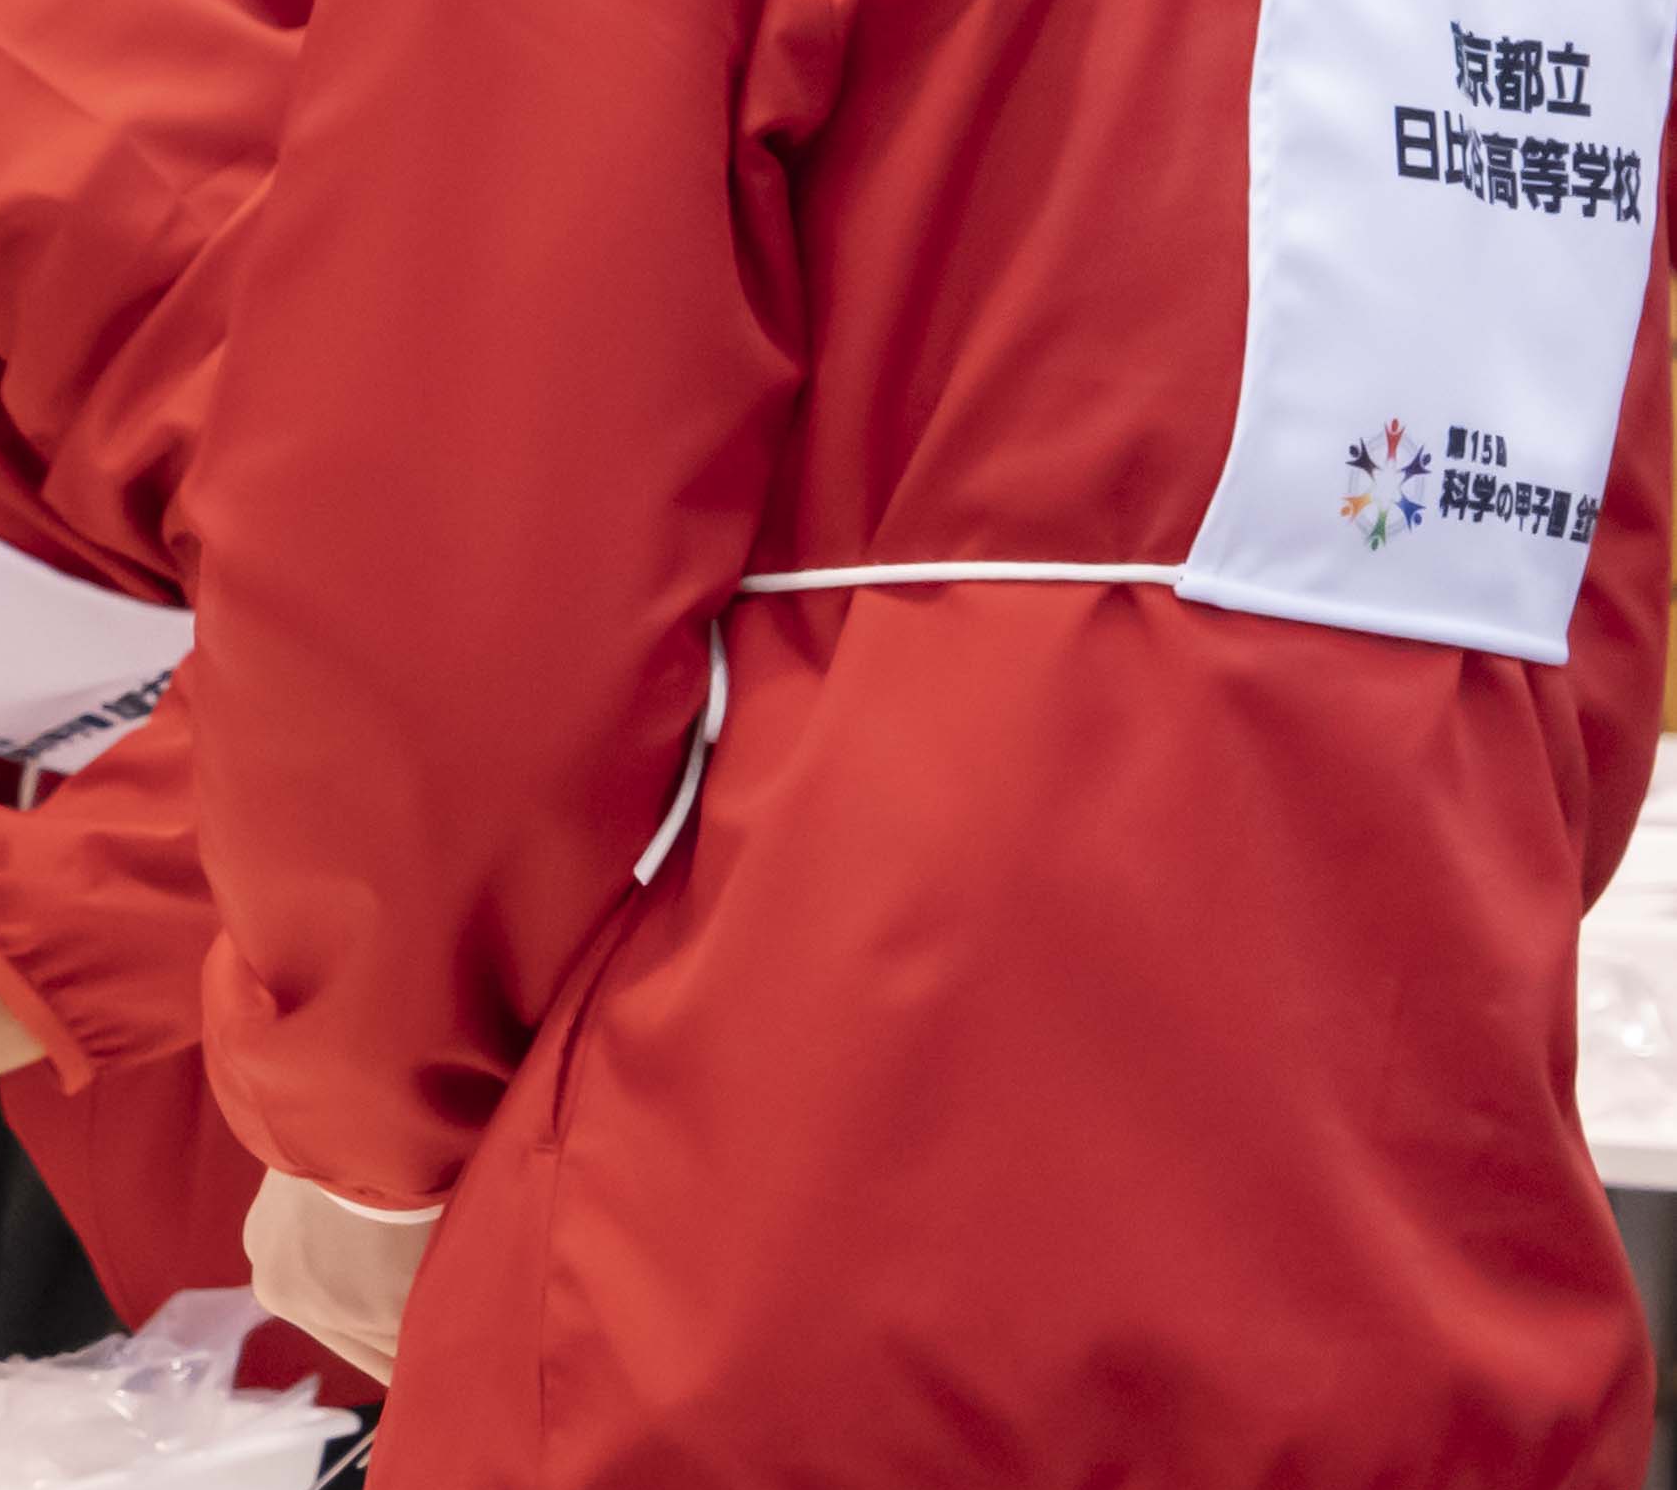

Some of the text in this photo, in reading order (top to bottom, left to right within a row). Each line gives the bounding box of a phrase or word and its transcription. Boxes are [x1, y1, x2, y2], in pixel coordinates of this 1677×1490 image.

[1440, 469, 1571, 538] 科学の甲子園
